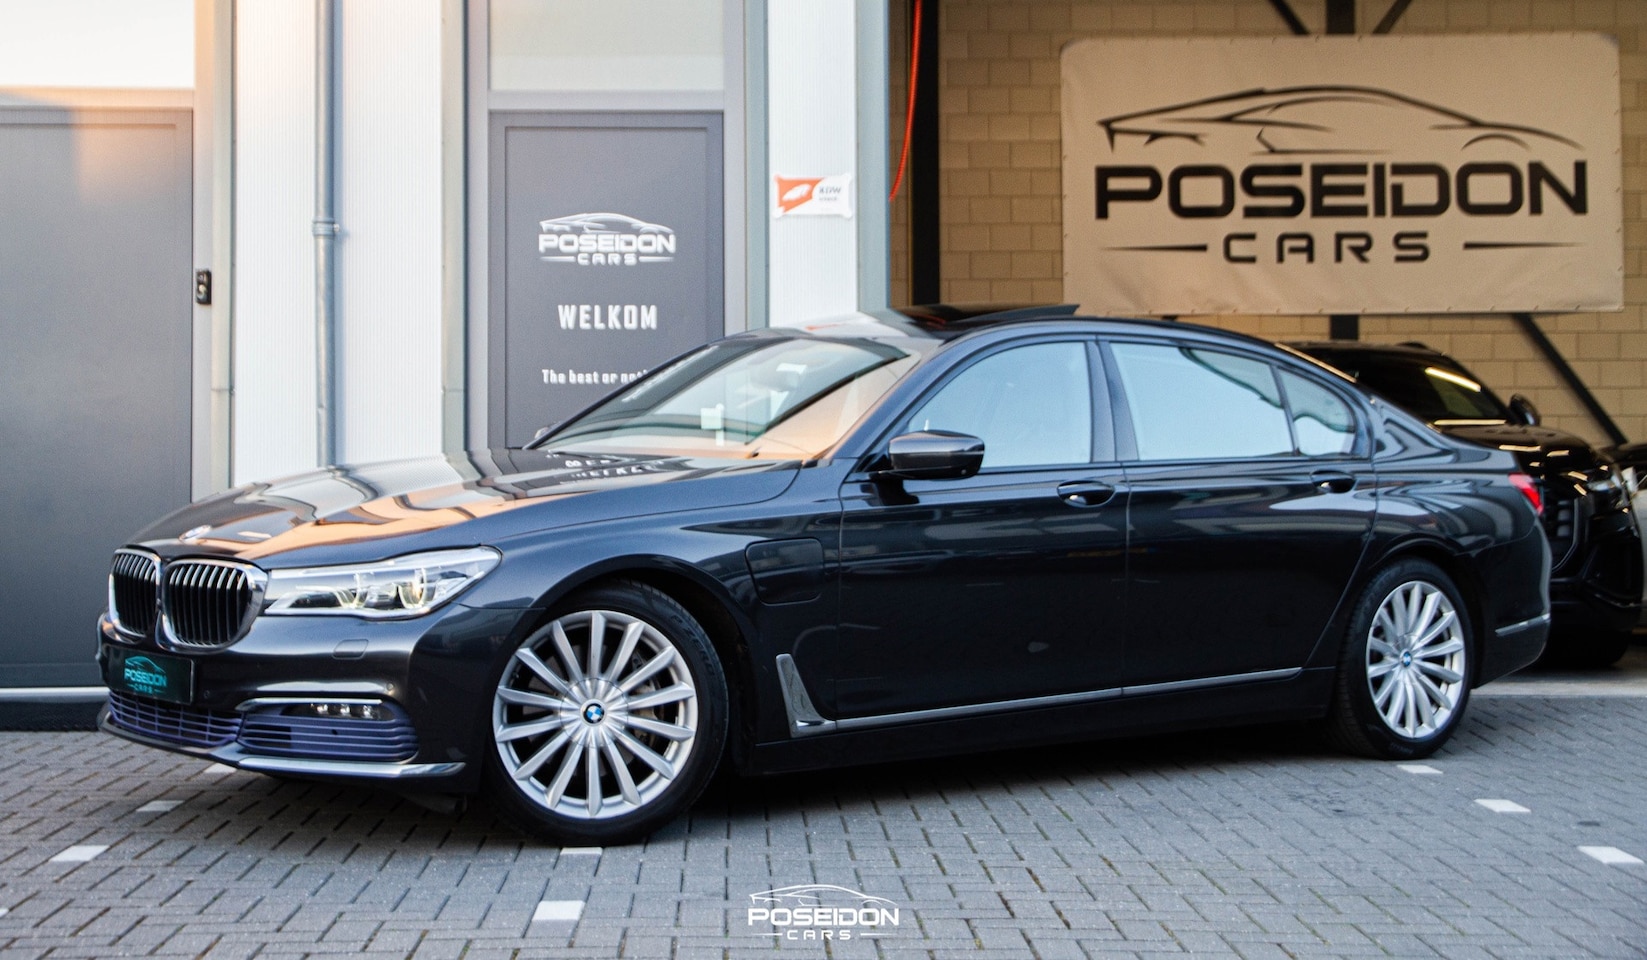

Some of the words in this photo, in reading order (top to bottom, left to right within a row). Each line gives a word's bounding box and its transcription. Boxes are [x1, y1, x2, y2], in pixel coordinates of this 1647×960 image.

[1094, 159, 1588, 220] POSEIDON
[538, 233, 676, 254] POSEIDON
[1222, 230, 1430, 264] CARS
[577, 252, 638, 266] CARS
[557, 304, 658, 330] WELKOM
[541, 369, 566, 384] The
[568, 369, 599, 384] best
[601, 372, 618, 385] or
[124, 667, 168, 687] POSEIDON
